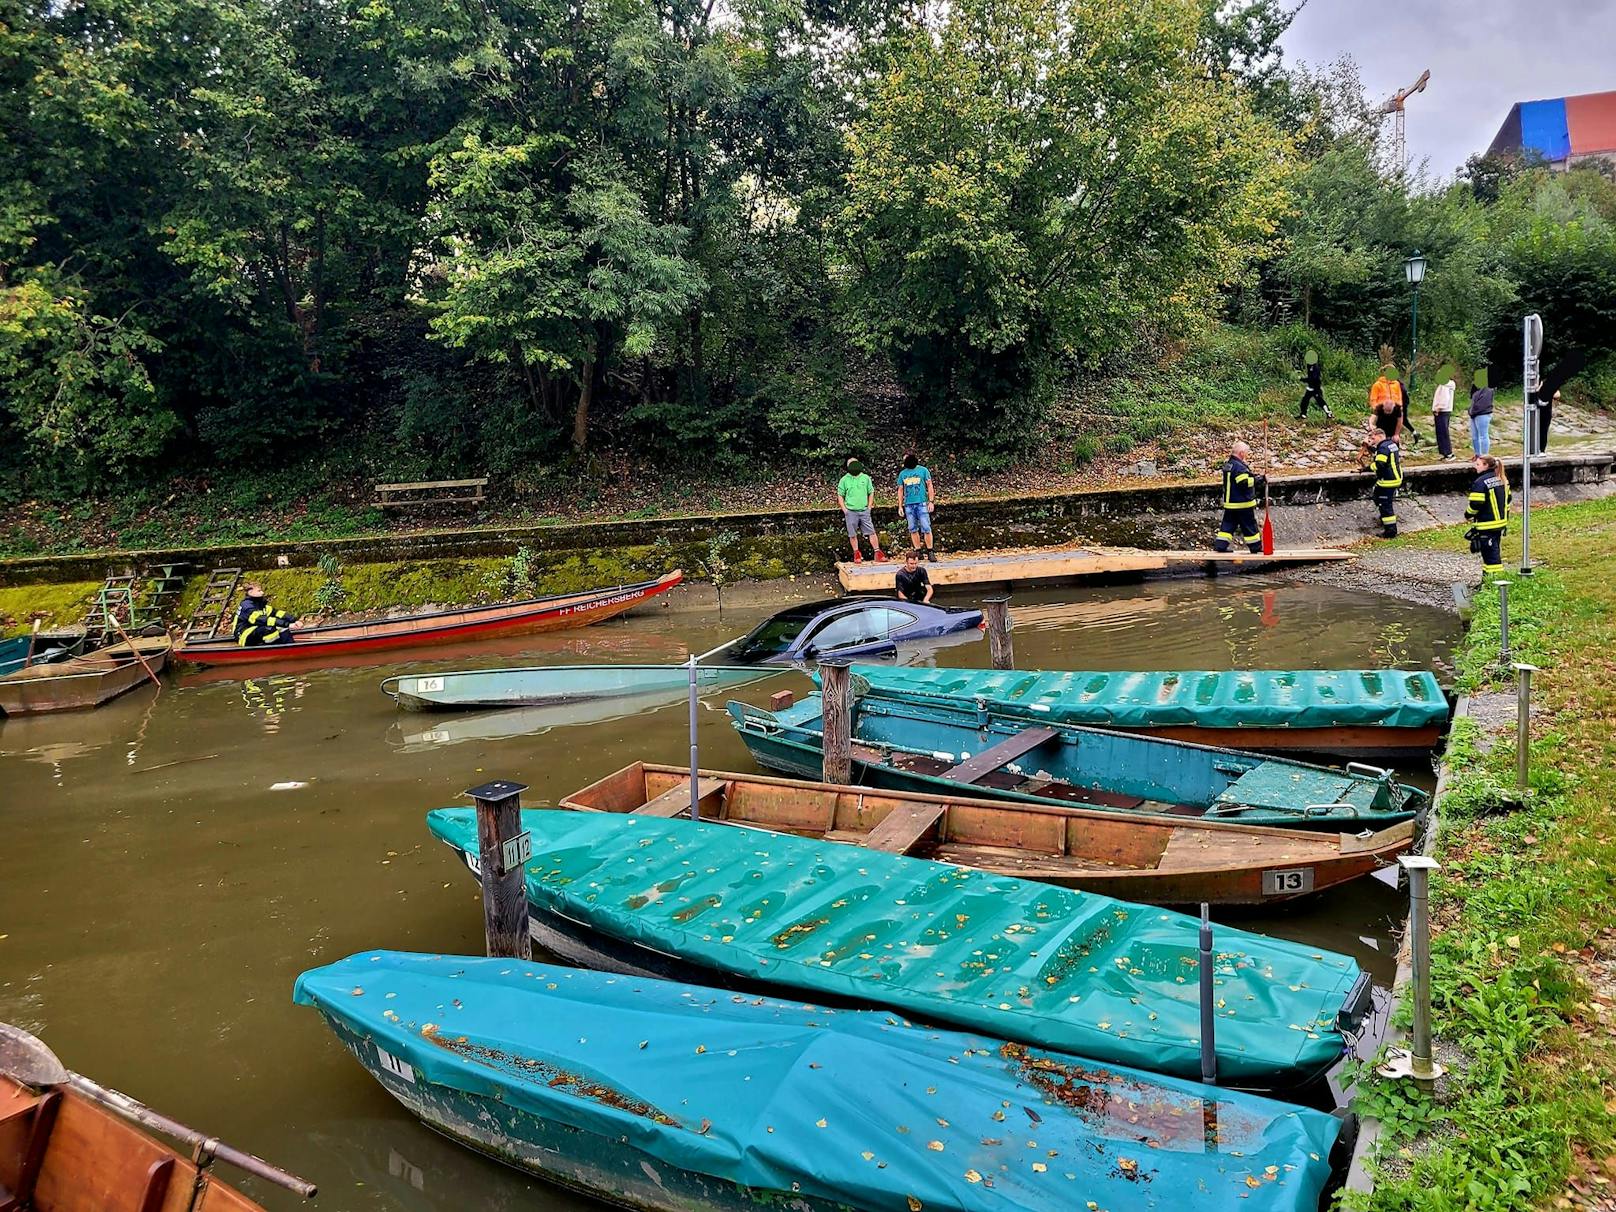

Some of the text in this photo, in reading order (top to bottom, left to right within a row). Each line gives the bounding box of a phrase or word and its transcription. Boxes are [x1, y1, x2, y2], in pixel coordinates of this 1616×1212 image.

[559, 590, 645, 616] FF REICHERSBERG
[424, 680, 437, 690] 16
[508, 839, 530, 864] 11 12
[1276, 873, 1302, 890] 13
[388, 1052, 402, 1073] 11
